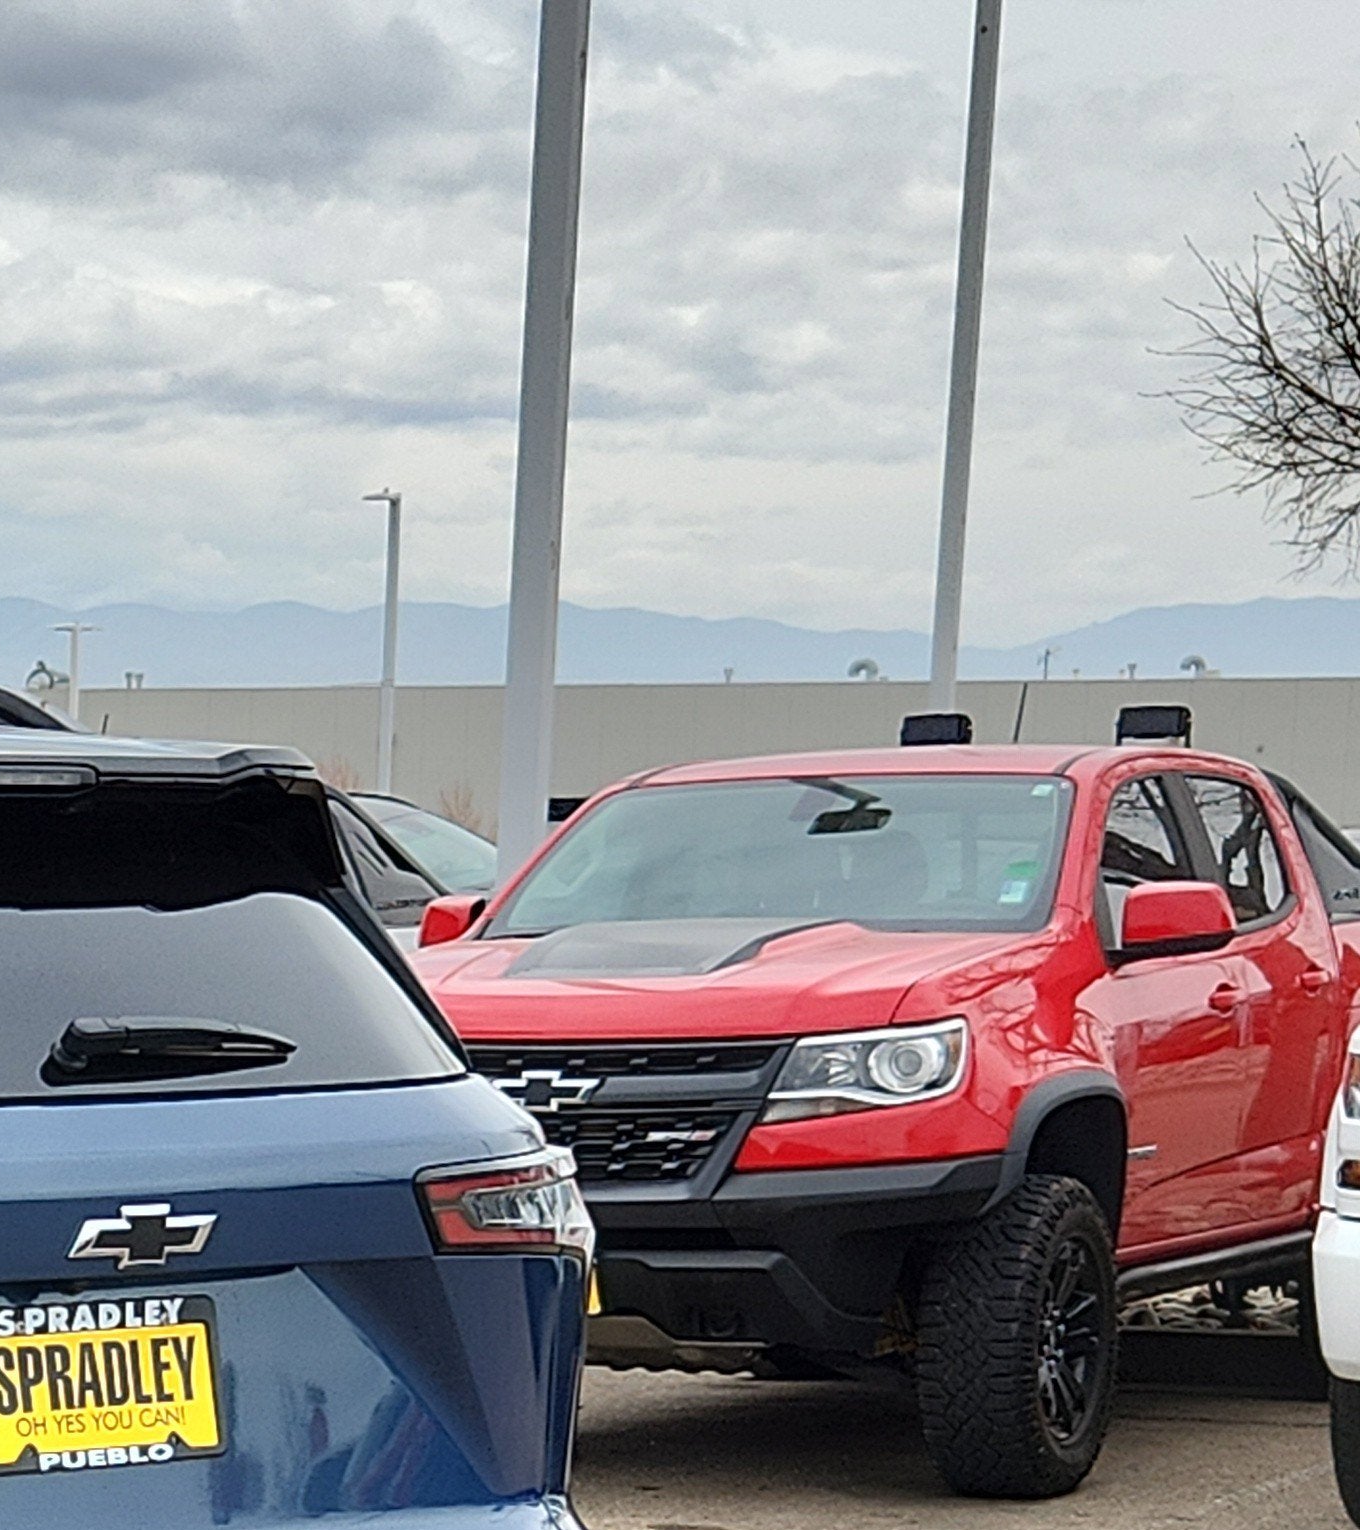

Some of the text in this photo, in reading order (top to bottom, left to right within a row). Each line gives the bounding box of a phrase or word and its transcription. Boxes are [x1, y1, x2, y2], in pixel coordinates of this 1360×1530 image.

[15, 1406, 187, 1437] OH YES YOU CAN!
[38, 1442, 175, 1472] PUEBLO
